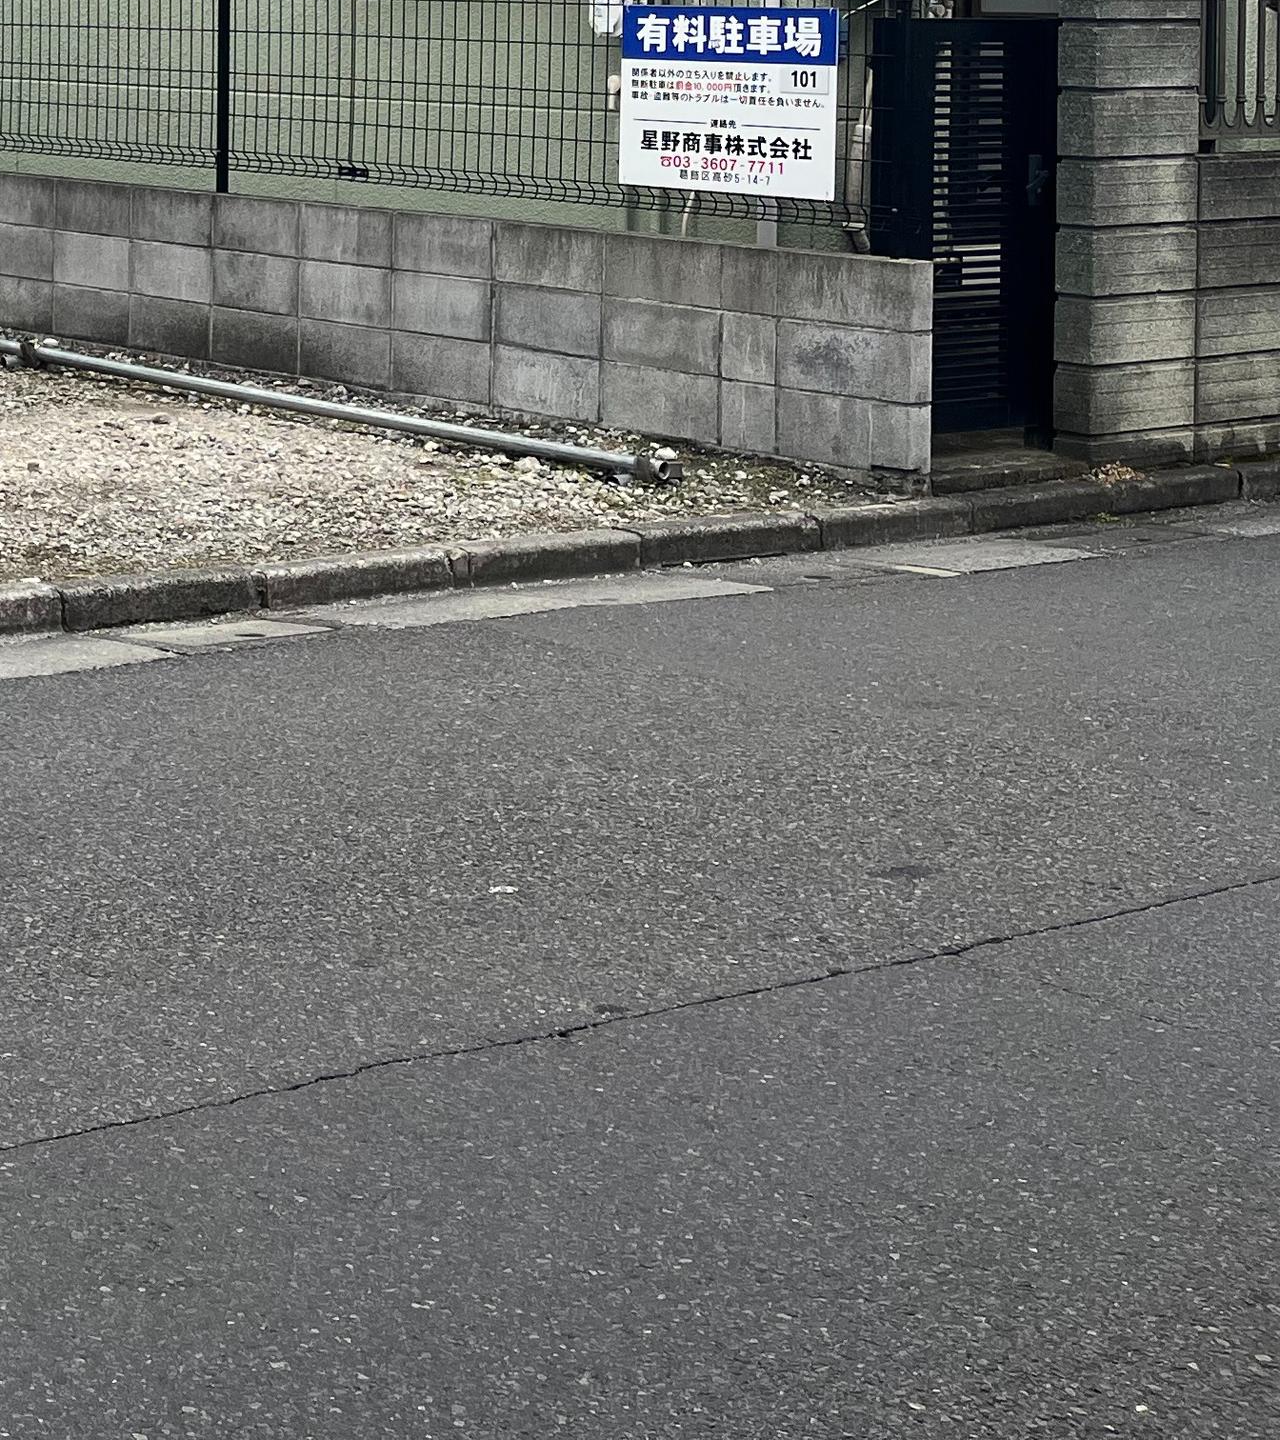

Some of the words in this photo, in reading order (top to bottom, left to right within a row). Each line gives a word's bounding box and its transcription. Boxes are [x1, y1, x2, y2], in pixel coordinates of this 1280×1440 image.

[636, 13, 823, 57] 有料駐車場
[791, 70, 817, 88] 101
[640, 129, 813, 161] 星野商事株式会社
[673, 155, 784, 175] 03-3607-7711
